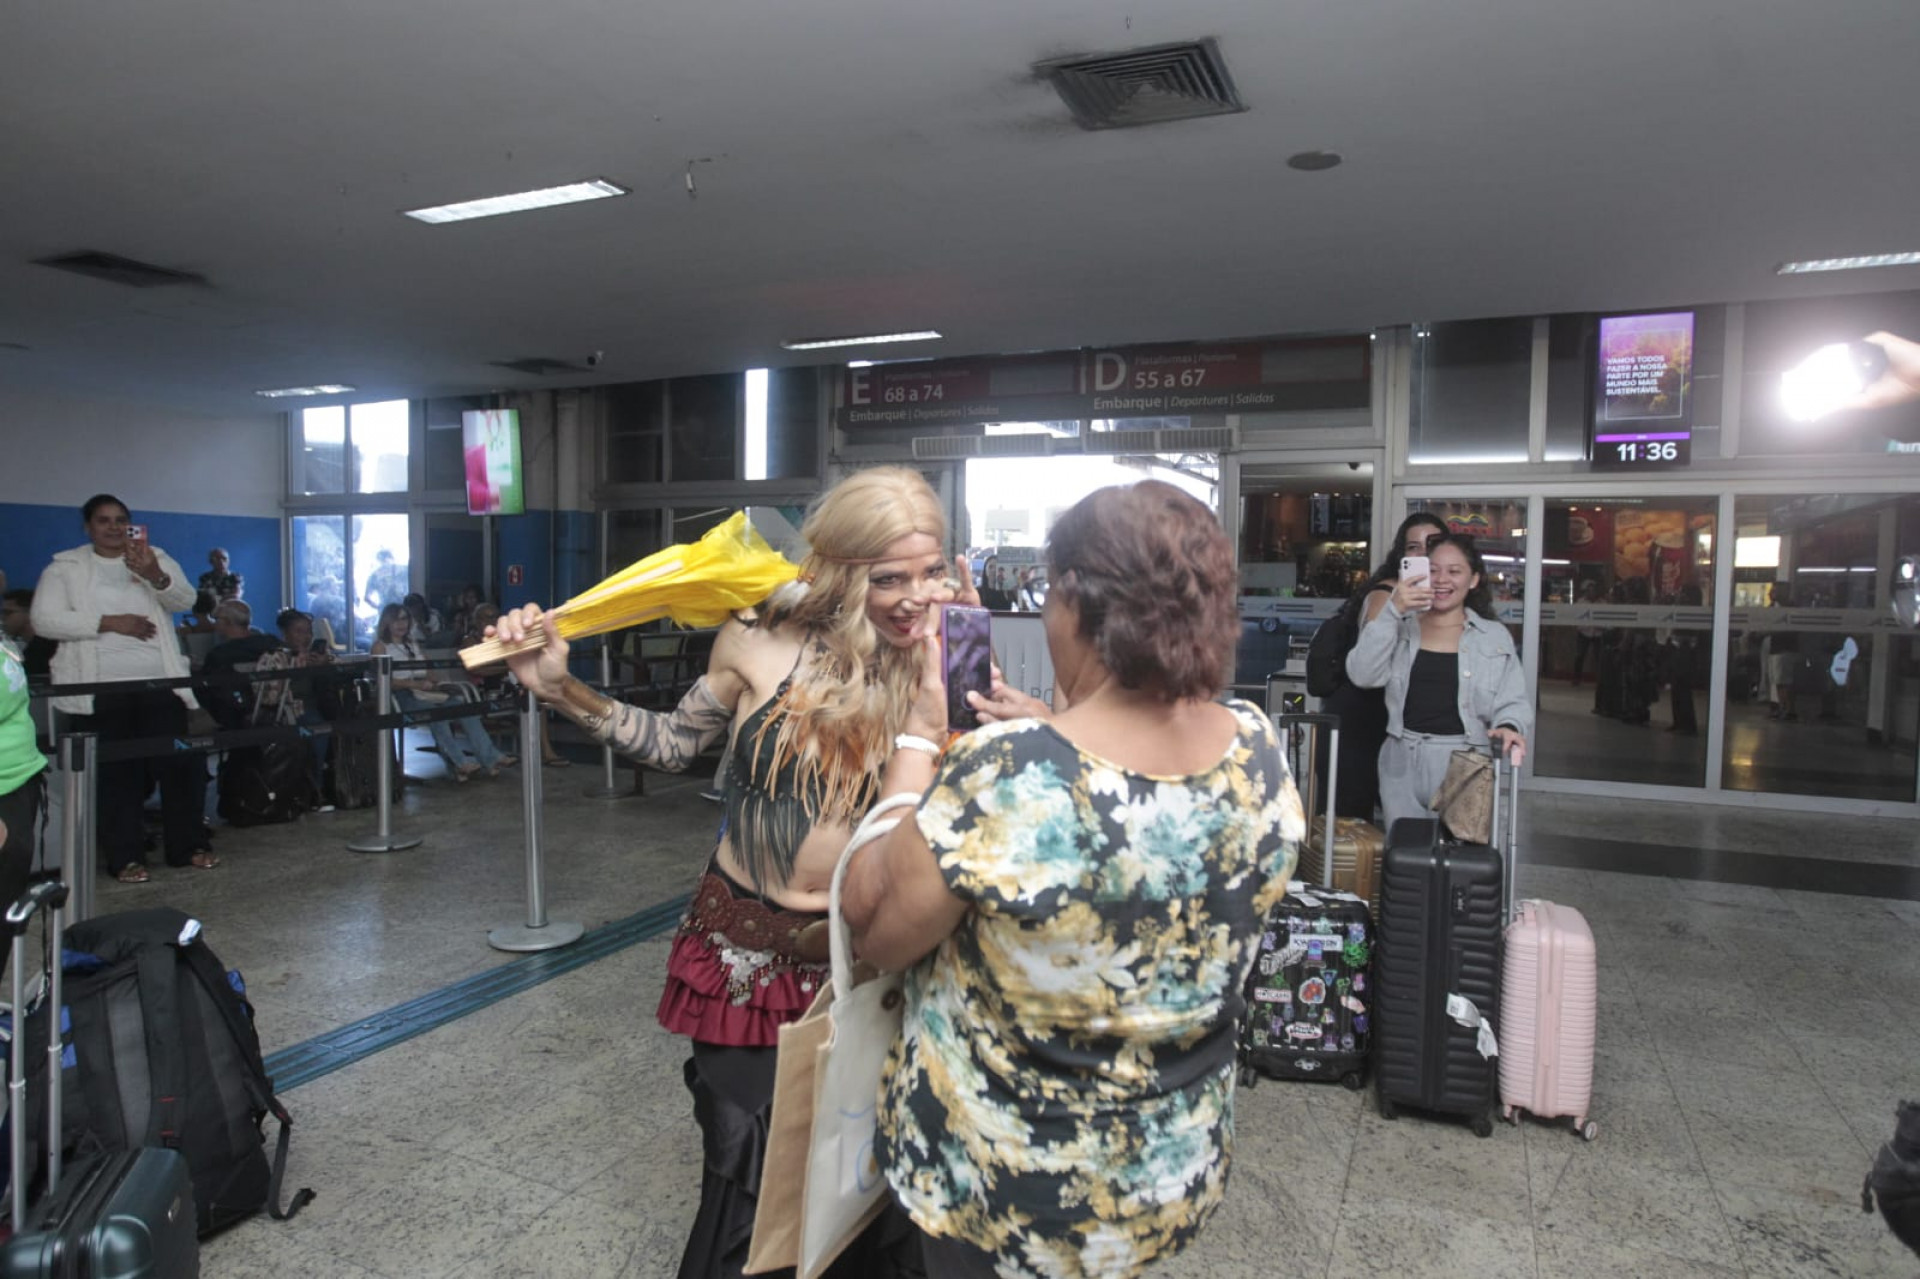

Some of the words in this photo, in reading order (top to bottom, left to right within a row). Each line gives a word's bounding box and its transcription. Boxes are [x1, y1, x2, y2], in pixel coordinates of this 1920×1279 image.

[1607, 357, 1635, 365] VAMOS
[1637, 355, 1665, 363] TODOS
[1607, 364, 1632, 372] FAZER
[1640, 363, 1668, 371] NOSSA
[1094, 352, 1128, 392] D
[1133, 371, 1159, 390] 55
[1163, 375, 1176, 388] a
[1180, 368, 1206, 387] 67
[1606, 372, 1631, 380] PARTE
[1632, 371, 1649, 379] POR
[1650, 370, 1664, 378] UM
[851, 370, 872, 405] E
[1606, 379, 1637, 387] MUNDO
[1637, 378, 1658, 386] MAIS
[884, 386, 906, 403] 68
[909, 389, 919, 402] a
[923, 384, 944, 401] 74
[1093, 396, 1162, 411] Embarque
[1170, 395, 1229, 409] Departures
[1235, 392, 1276, 405] Salidas
[849, 409, 907, 423] Embarque
[913, 407, 962, 420] Departures
[967, 404, 1000, 417] Salidas
[1617, 442, 1678, 461] 11:36
